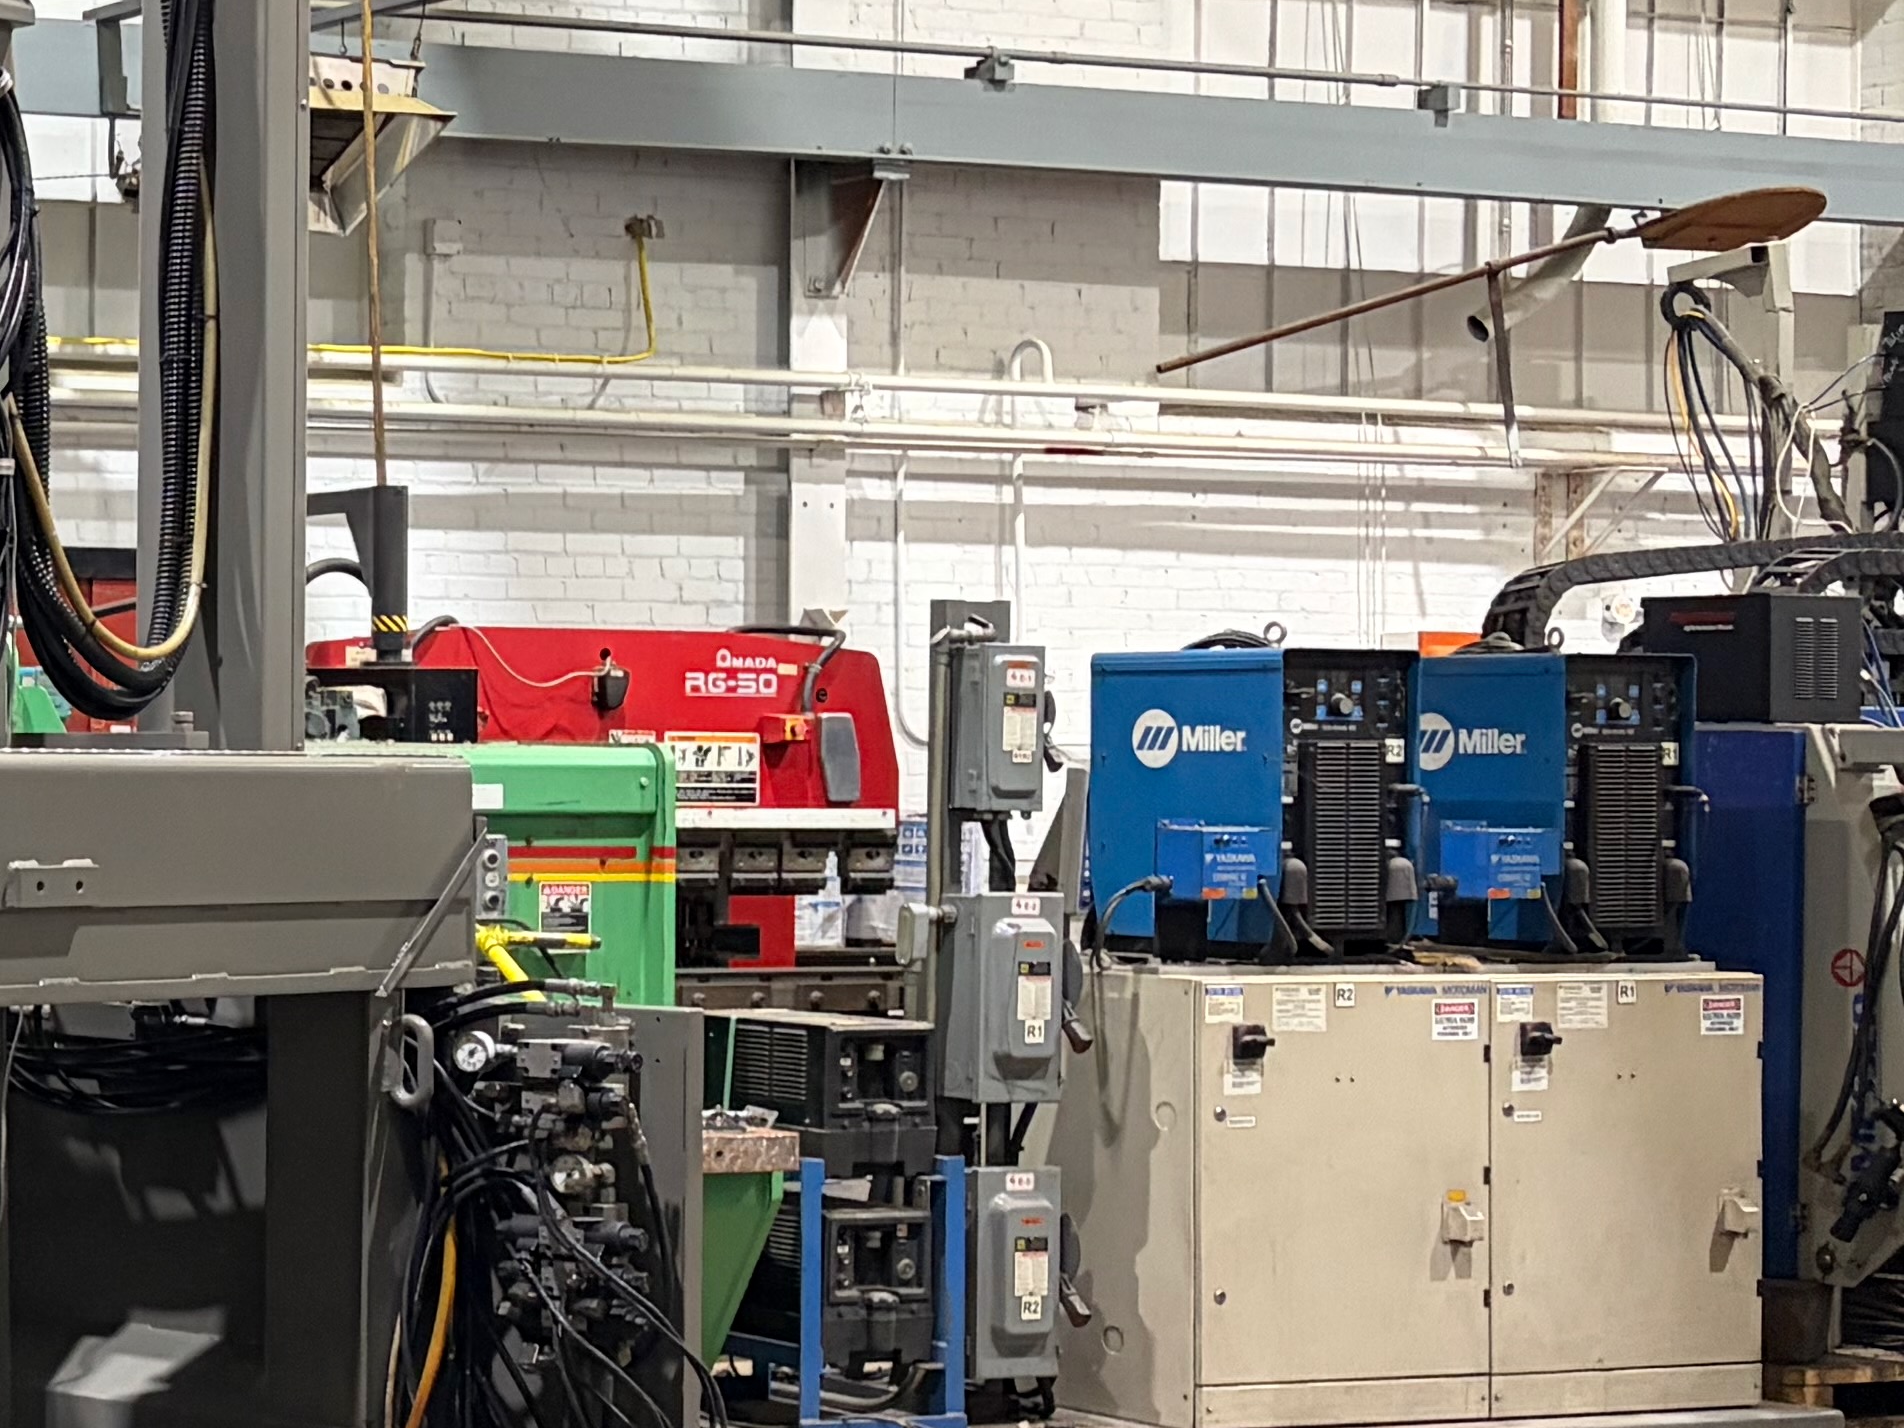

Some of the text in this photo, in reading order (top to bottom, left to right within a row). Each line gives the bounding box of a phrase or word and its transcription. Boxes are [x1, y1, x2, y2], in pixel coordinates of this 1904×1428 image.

[715, 647, 778, 669] AMADA
[684, 671, 778, 694] RG-50
[1181, 725, 1246, 752] Miller
[1458, 728, 1526, 754] Miller
[1387, 744, 1402, 758] R2
[1664, 748, 1678, 761] R1
[1337, 987, 1354, 1001] R2
[1620, 984, 1635, 998] R1
[1026, 1024, 1042, 1038] R1
[1022, 1300, 1040, 1315] R2
